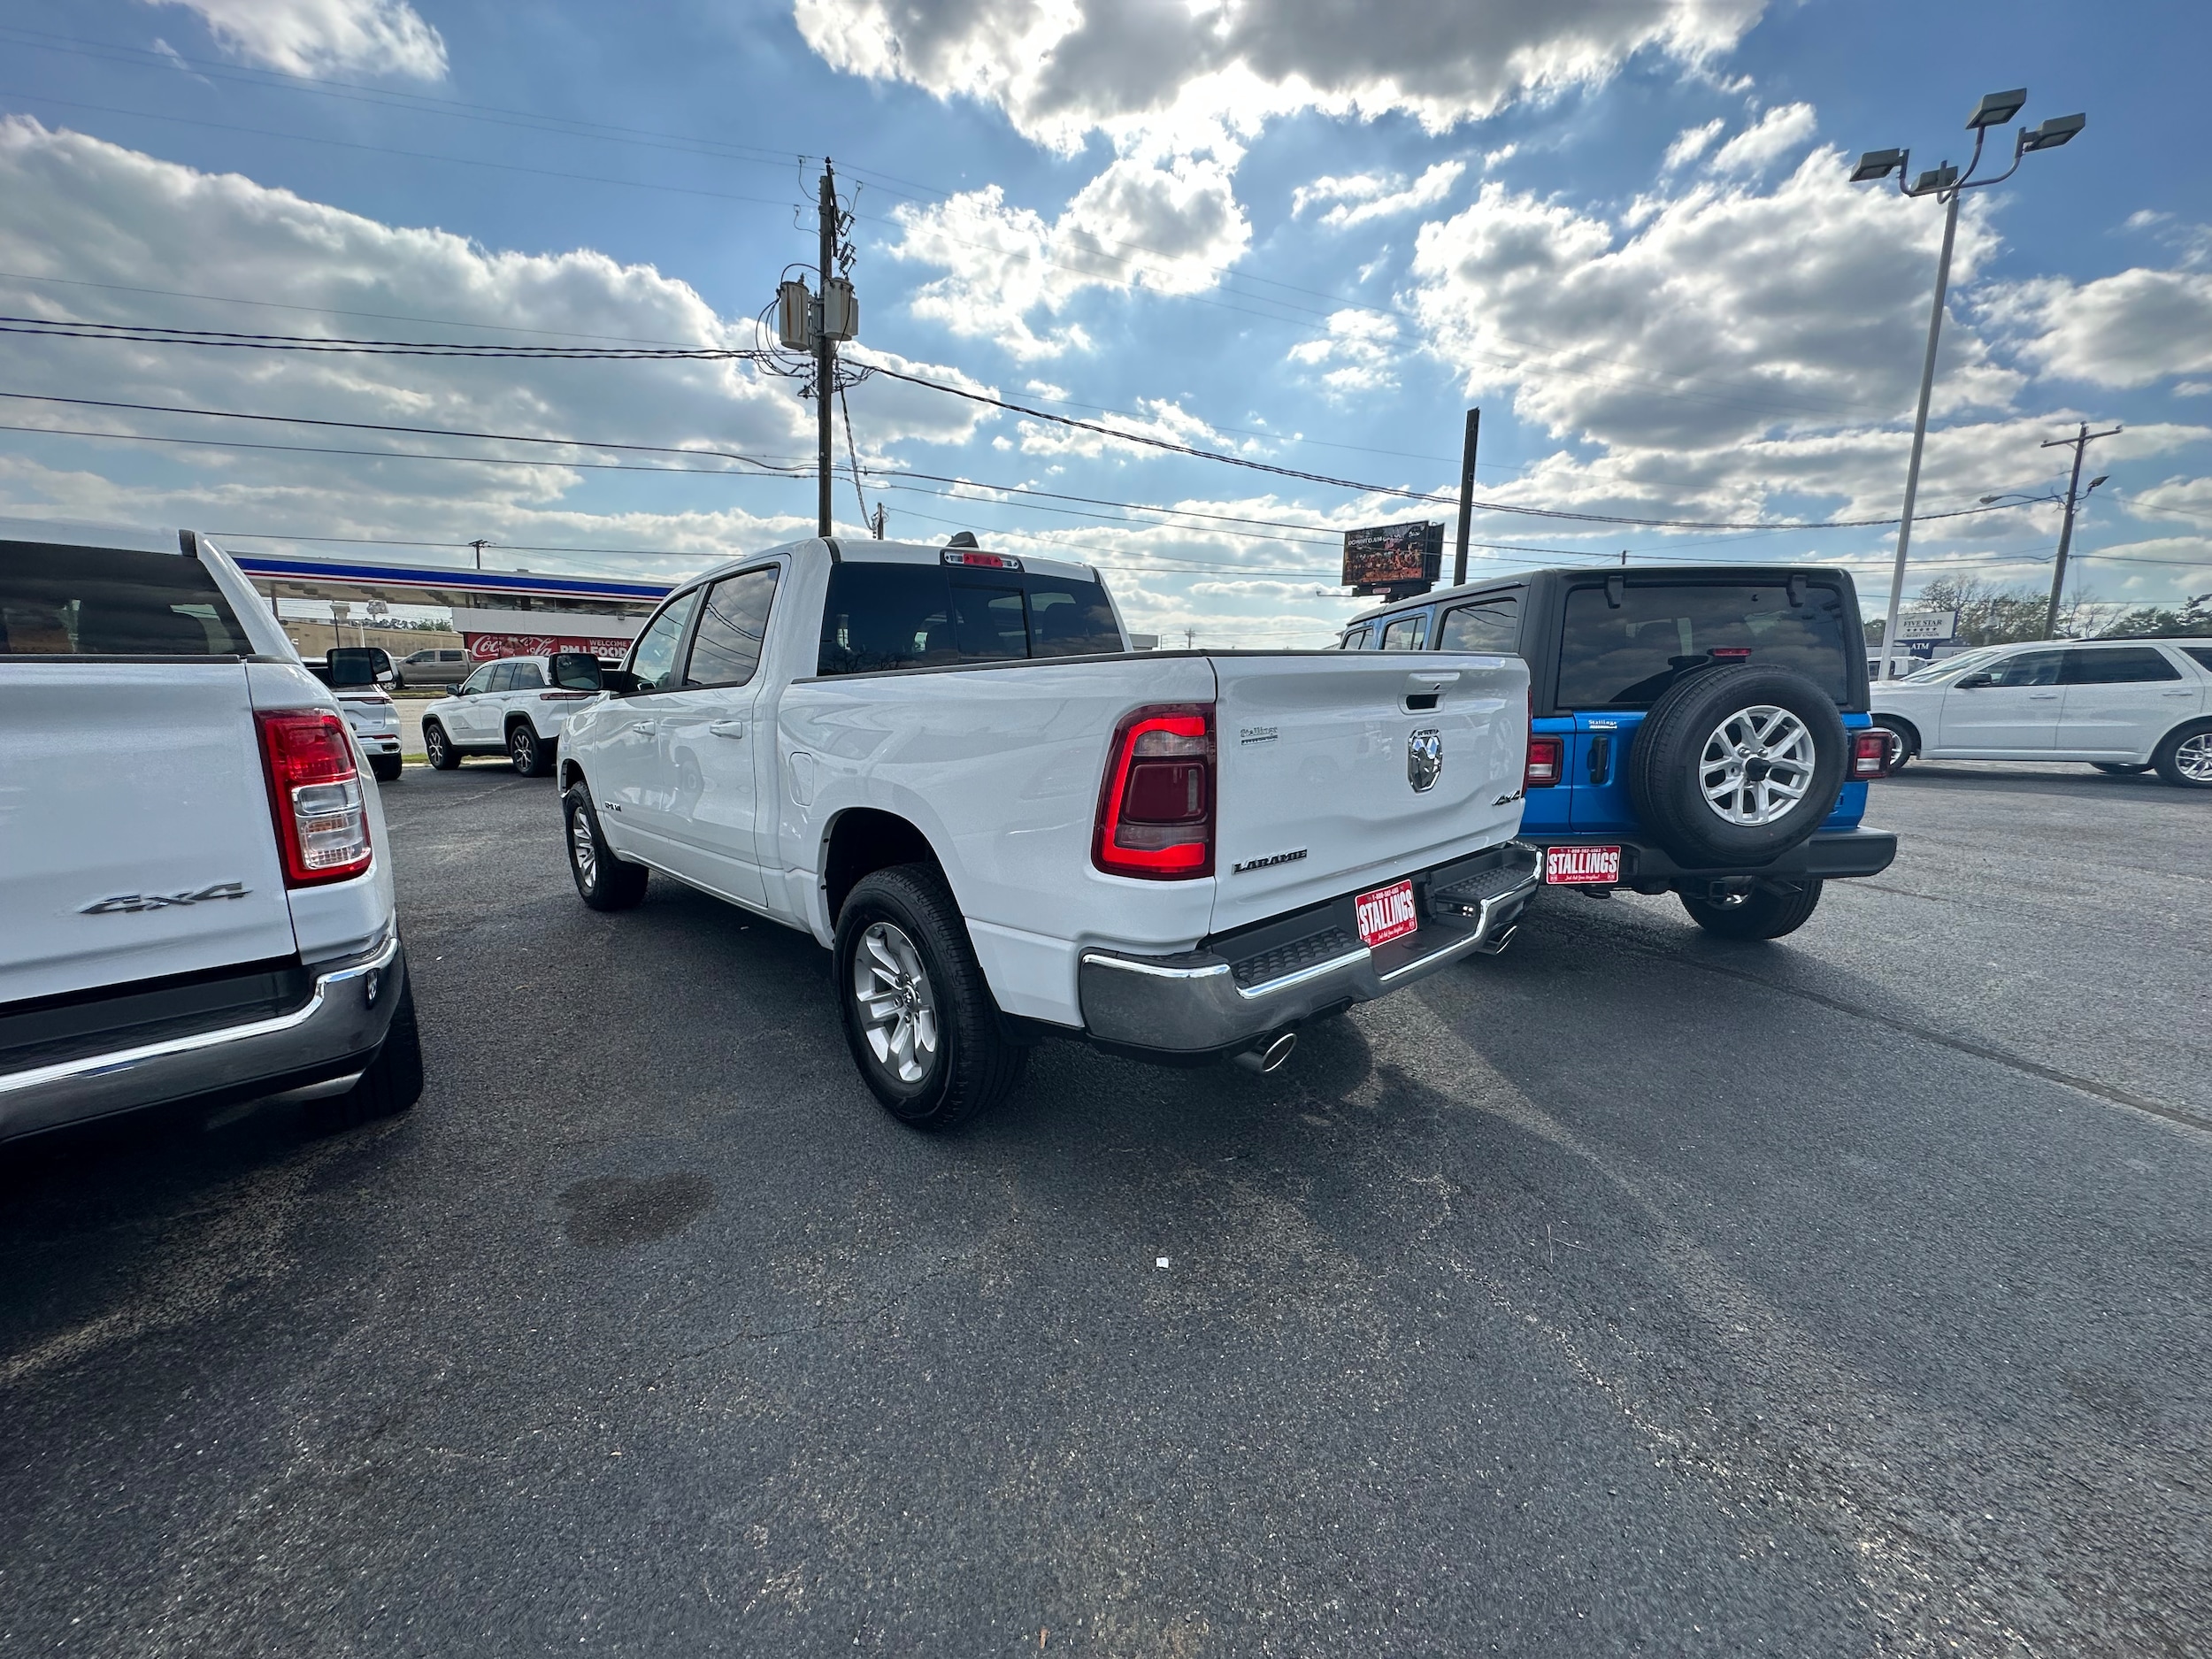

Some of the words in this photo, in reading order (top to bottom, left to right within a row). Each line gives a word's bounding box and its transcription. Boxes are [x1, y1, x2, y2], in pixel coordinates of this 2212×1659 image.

[472, 634, 503, 657] Coc
[1233, 849, 1308, 874] LARAMIE
[1549, 852, 1617, 874] STALLINGS
[1359, 889, 1415, 936] STALLINGS
